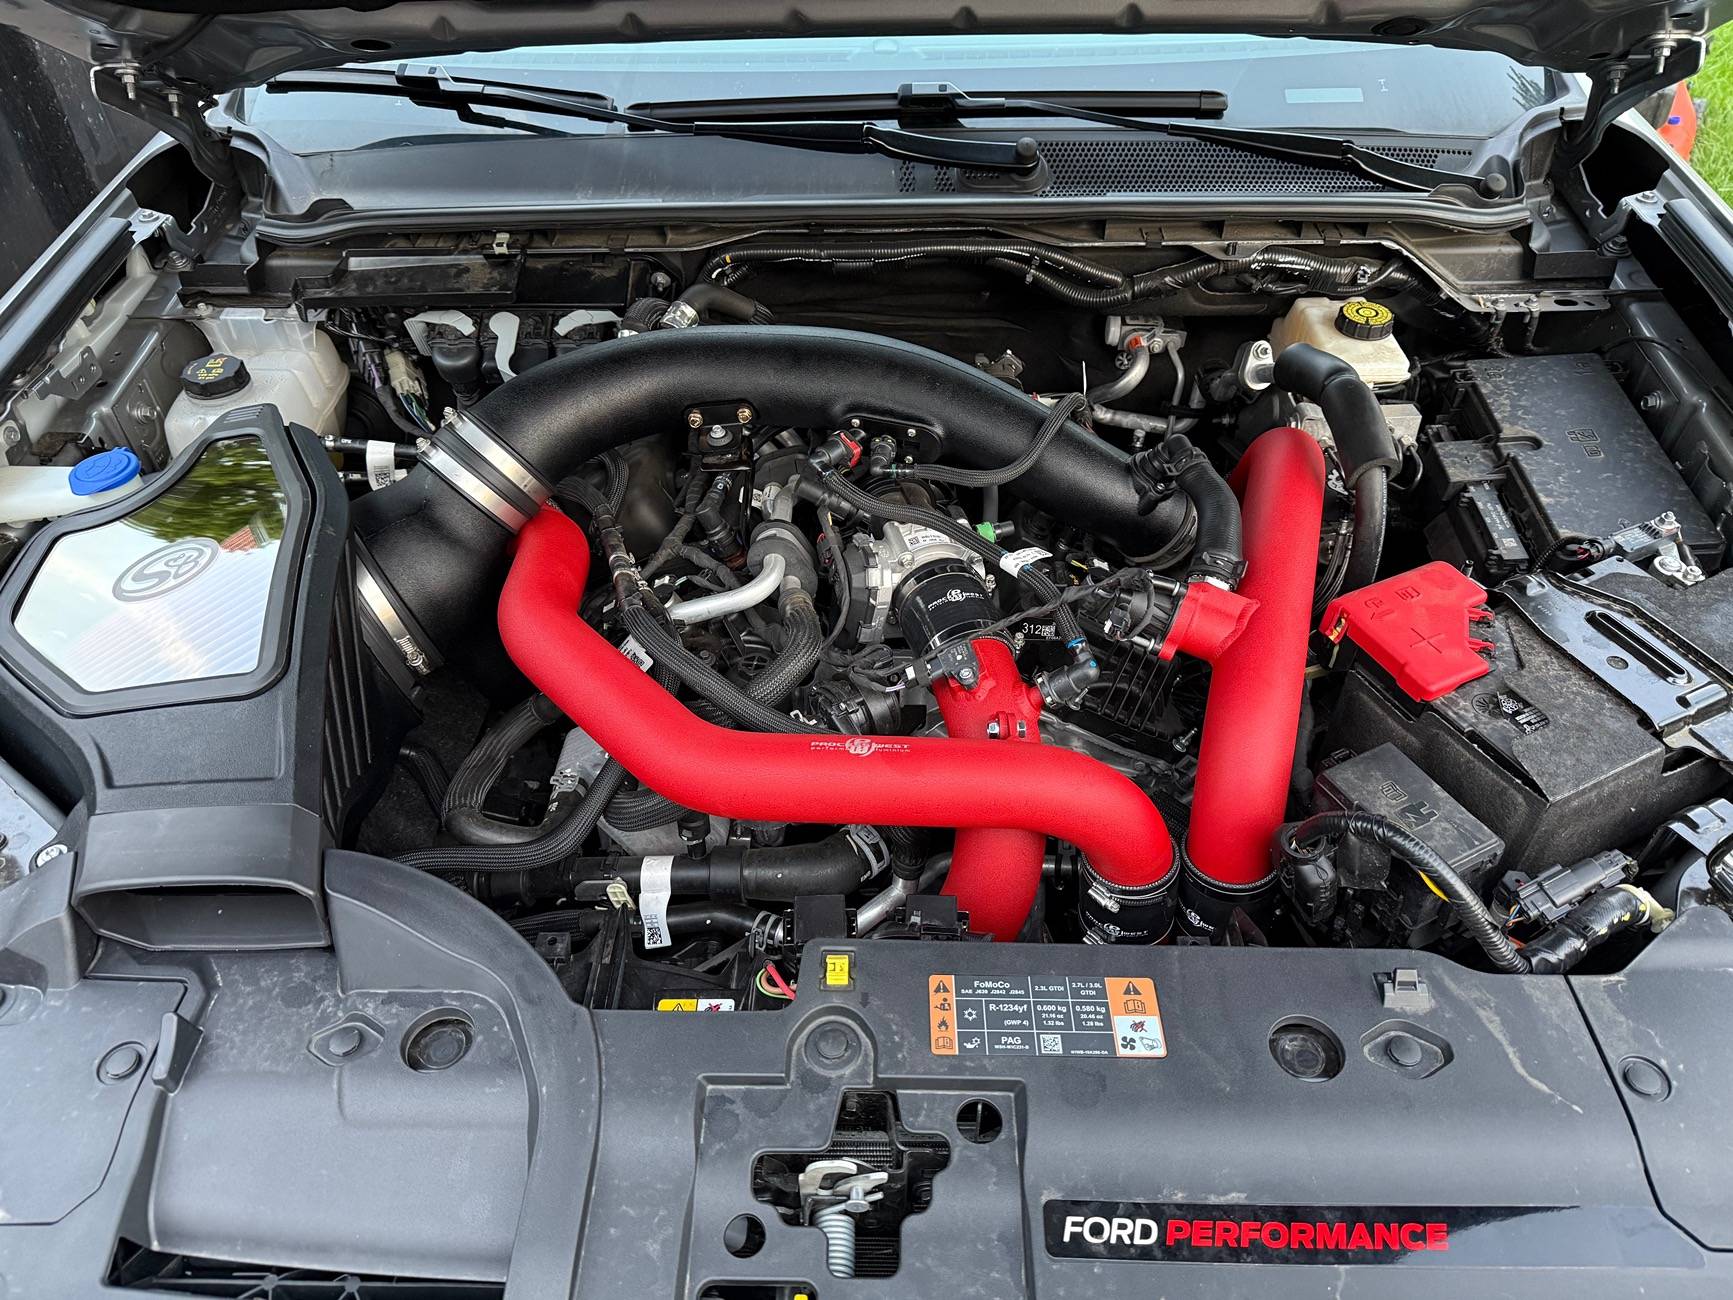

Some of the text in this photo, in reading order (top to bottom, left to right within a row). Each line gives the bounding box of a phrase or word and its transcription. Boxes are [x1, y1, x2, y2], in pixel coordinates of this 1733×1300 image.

[1022, 622, 1042, 635] 312
[974, 981, 1010, 989] FoMoCo
[989, 1003, 1028, 1013] R-1234yf
[1036, 1004, 1067, 1013] 0.600 kg
[1096, 1005, 1106, 1013] kg
[1001, 1036, 1022, 1044] PAG
[1063, 1216, 1449, 1250] FORD PERFORMANCE
